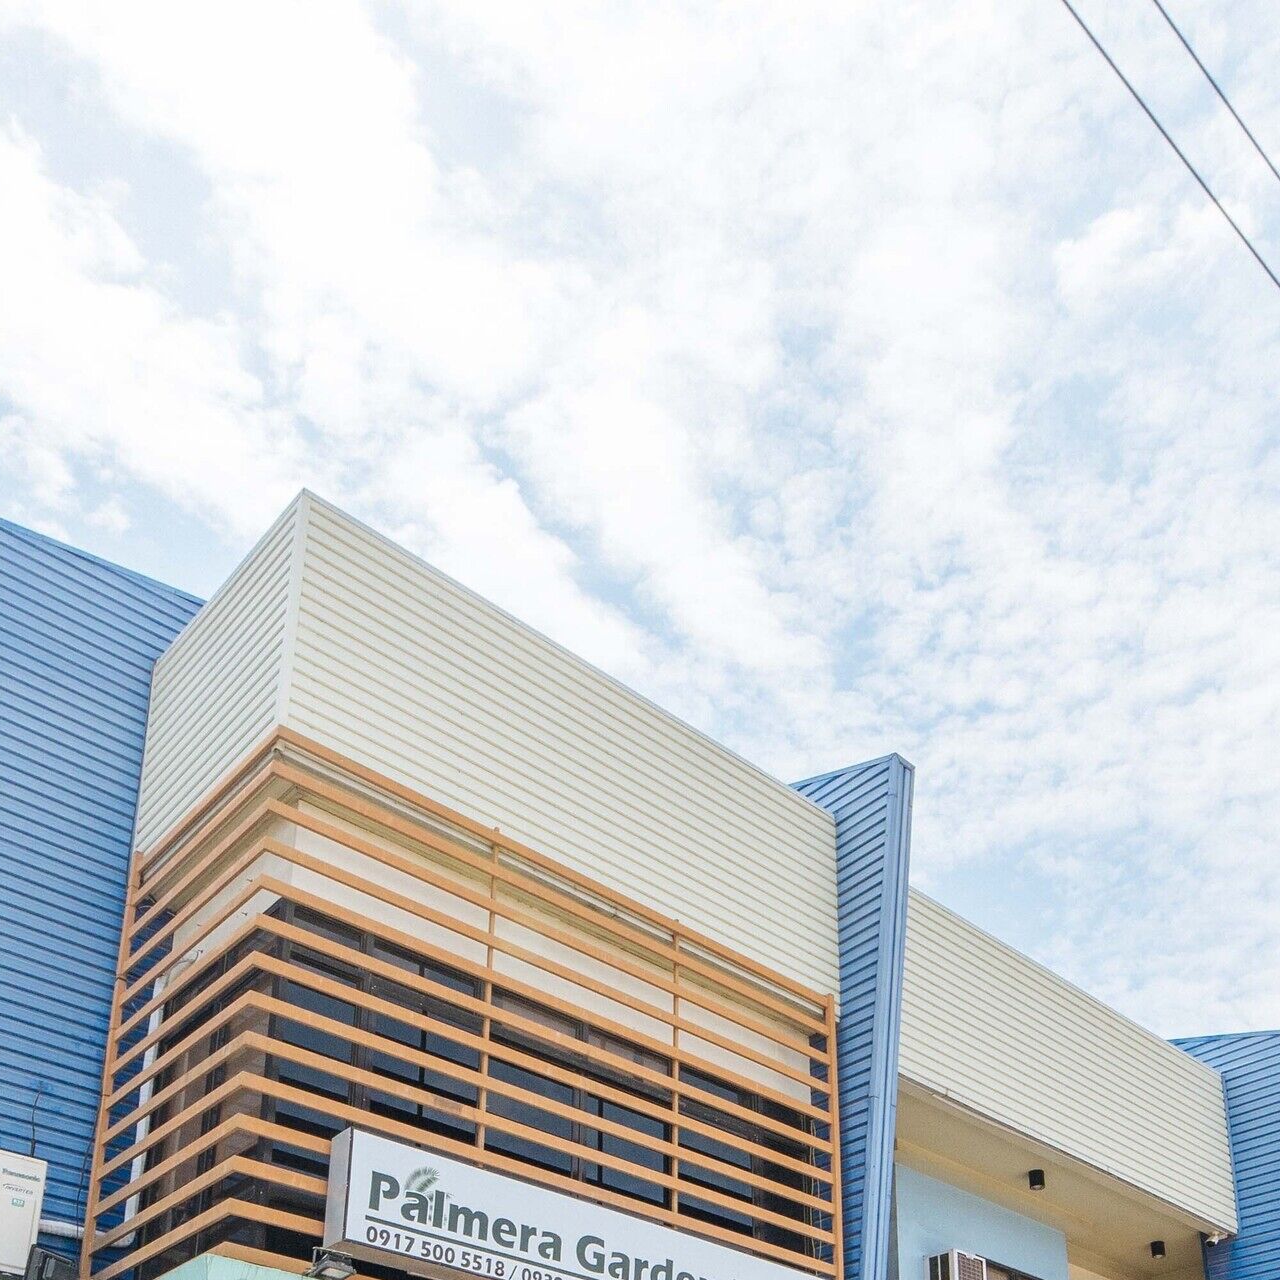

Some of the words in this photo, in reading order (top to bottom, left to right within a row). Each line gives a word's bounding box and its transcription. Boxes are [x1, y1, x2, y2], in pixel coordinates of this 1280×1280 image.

[366, 1225, 415, 1252] 0917
[421, 1241, 456, 1264] 500
[460, 1251, 505, 1277] 5518
[368, 1170, 563, 1262] Palmera
